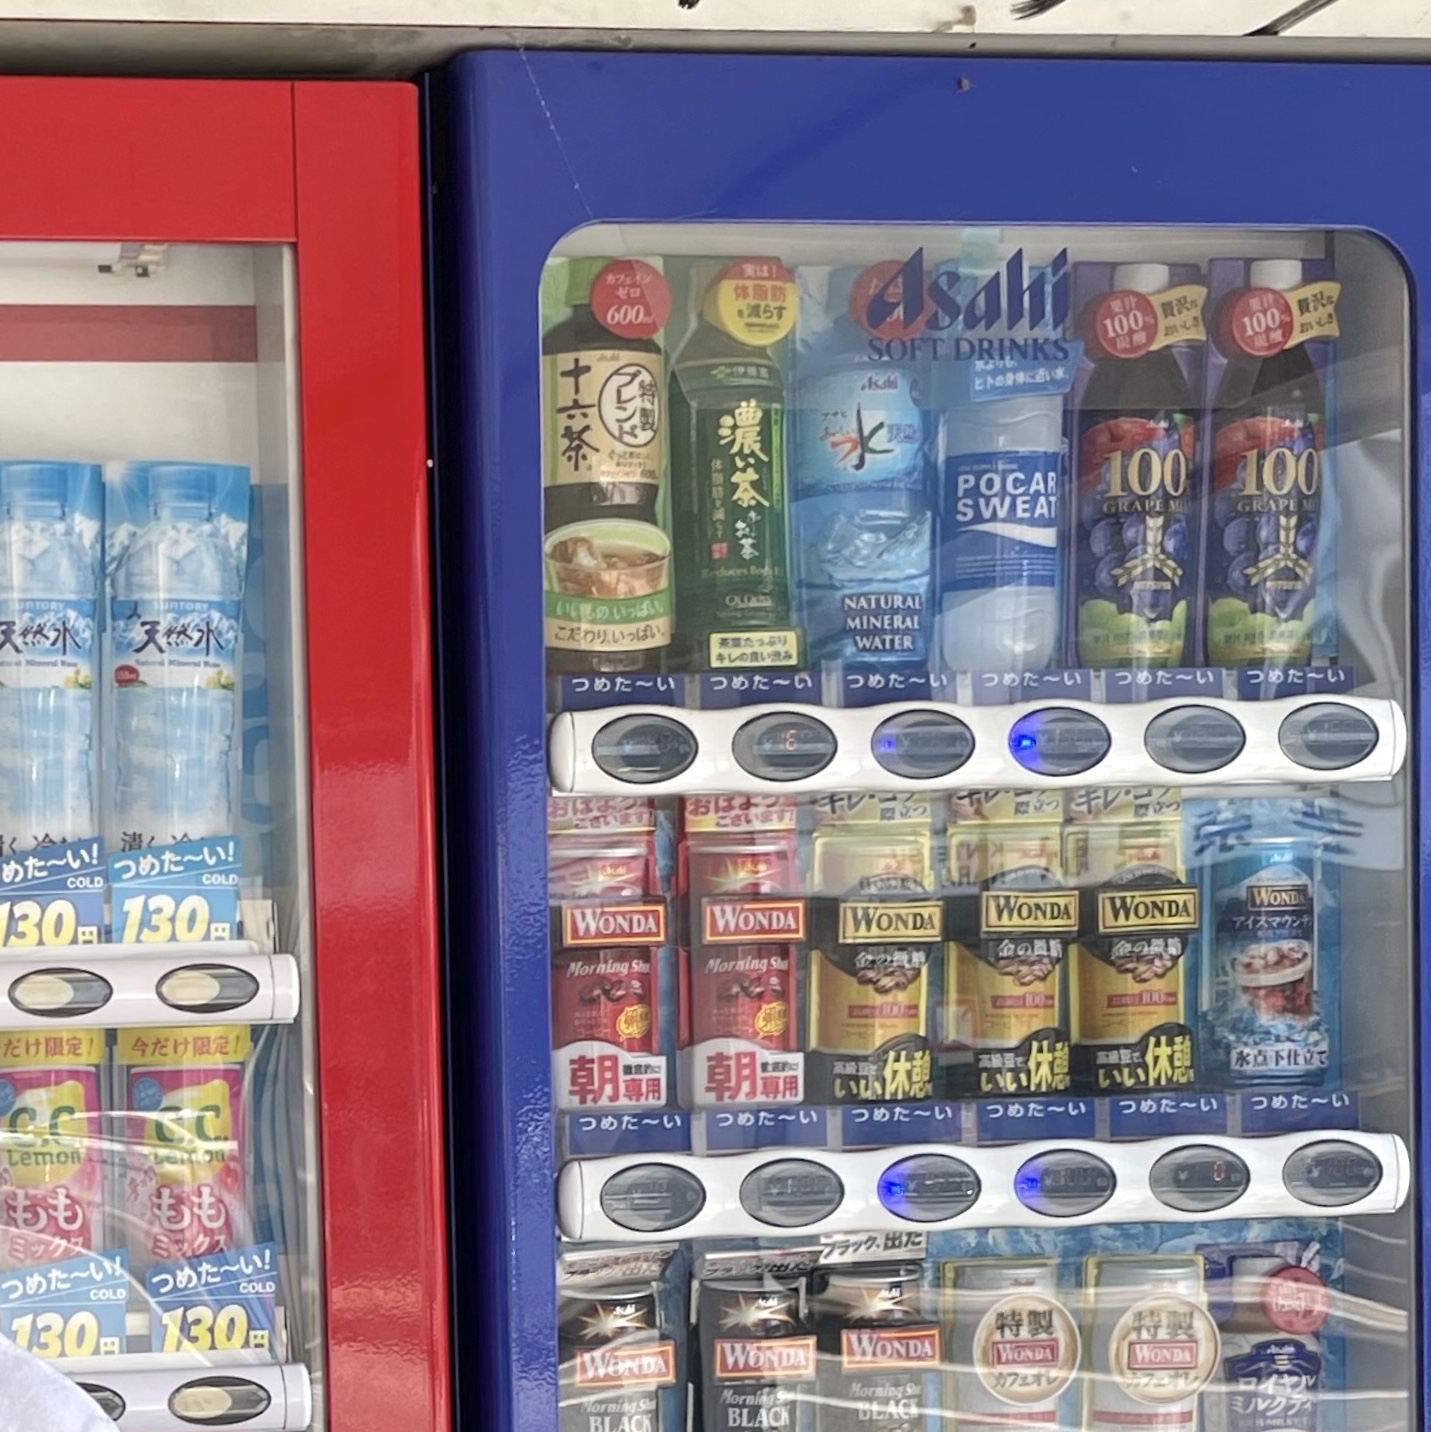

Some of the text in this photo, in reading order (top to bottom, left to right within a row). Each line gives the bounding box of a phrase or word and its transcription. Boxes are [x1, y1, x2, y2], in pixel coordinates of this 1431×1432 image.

[865, 246, 1068, 331] Asahi
[867, 337, 1069, 361] SOFT DRINKS
[556, 357, 600, 472] 十六茶
[719, 397, 770, 509] 濃い茶
[1102, 447, 1188, 498] 100
[1238, 446, 1319, 497] 100
[956, 498, 1058, 522] SWEAT
[1102, 500, 1165, 513] GRAPE
[1237, 499, 1298, 513] GRAPE
[843, 595, 922, 611] NATURAL
[845, 616, 921, 631] MINERAL
[131, 619, 226, 657] 天然水
[854, 635, 915, 651] WATER
[66, 876, 104, 889] COLD
[201, 872, 239, 885] COLD
[991, 896, 1072, 923] WONDA
[1110, 896, 1192, 922] WONDA
[1252, 889, 1306, 908] WONDA
[122, 894, 231, 944] 130円
[573, 908, 658, 938] WONDA
[711, 904, 798, 932] WONDA
[850, 904, 936, 933] WONDA
[567, 960, 629, 977] Morning
[704, 957, 768, 974] Morning
[130, 1033, 242, 1058] 今だけ限定!
[568, 1053, 620, 1105] 朝
[623, 1078, 662, 1101] 専用
[704, 1050, 759, 1105] 朝
[761, 1074, 800, 1100] 専用
[7, 1148, 82, 1167] Lemon
[6, 1176, 85, 1233] もも
[153, 1176, 228, 1231] もも
[6, 1236, 85, 1261] ミックス
[150, 1233, 228, 1260] ミックス
[89, 1287, 127, 1301] COLD
[239, 1280, 277, 1294] COLD
[10, 1310, 119, 1359] 130円
[161, 1304, 269, 1353] 130円
[994, 1307, 1055, 1337] 特製
[1130, 1309, 1196, 1341] 特製
[721, 1341, 807, 1370] WONDA
[848, 1333, 934, 1361] WONDA
[997, 1342, 1054, 1362] WONDA
[1133, 1344, 1193, 1363] WONDA
[581, 1352, 669, 1379] WONDA
[849, 1380, 903, 1396] Morning
[992, 1369, 1060, 1389] カフェオレ
[719, 1389, 774, 1407] Morning
[726, 1404, 792, 1428] BLACK
